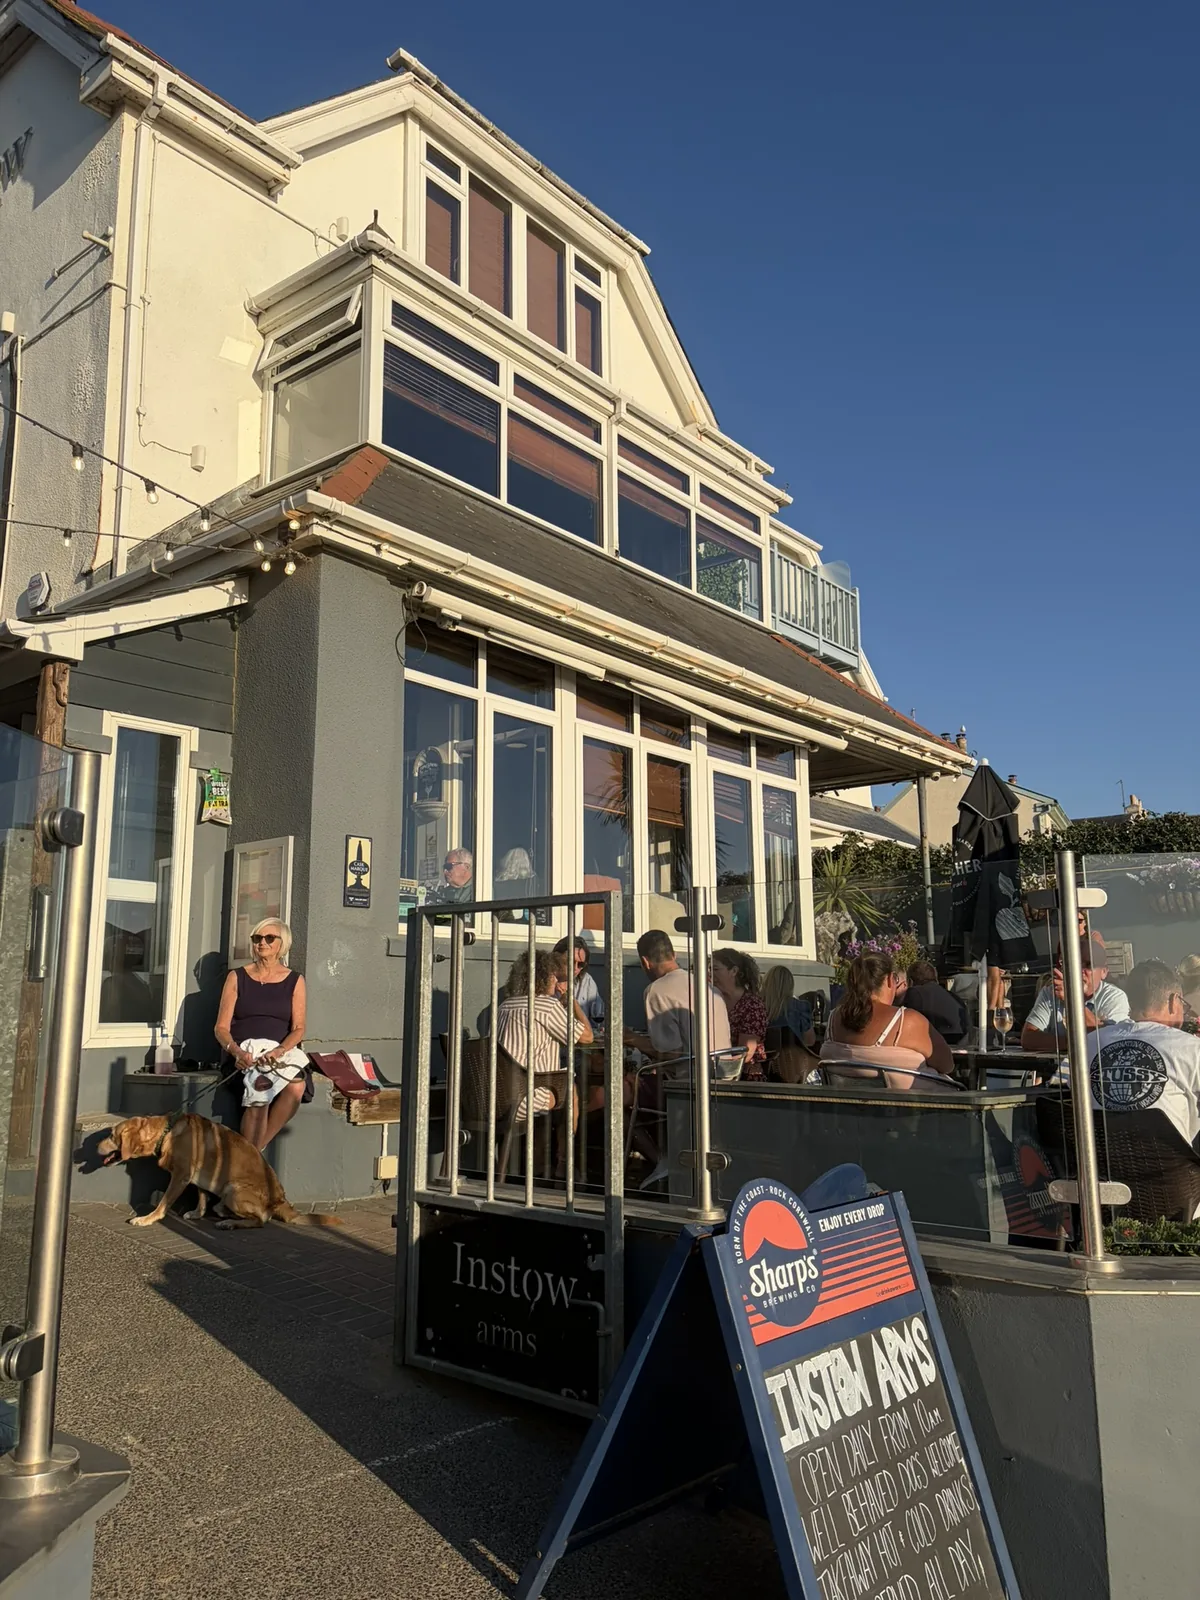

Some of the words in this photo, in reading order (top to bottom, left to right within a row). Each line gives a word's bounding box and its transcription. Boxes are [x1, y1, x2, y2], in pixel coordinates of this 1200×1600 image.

[1091, 1066, 1161, 1082] STUSSY
[733, 1219, 741, 1233] OF
[736, 1200, 748, 1217] THE
[788, 1197, 816, 1244] CORNWALL
[818, 1214, 844, 1233] ENJOY
[843, 1208, 867, 1225] EVERY
[866, 1203, 885, 1219] DROP
[733, 1236, 744, 1264] BORN
[452, 1241, 578, 1309] Instow
[749, 1255, 819, 1297] Sharp's
[762, 1290, 799, 1309] BREWING
[806, 1284, 817, 1294] CO
[477, 1320, 537, 1356] arms
[871, 1316, 937, 1410] ARMS
[799, 1441, 844, 1506] OPEN
[841, 1419, 879, 1478] DAILY
[877, 1406, 918, 1460] FROM
[800, 1503, 846, 1565] WELL
[841, 1469, 899, 1537] BEHAVED
[897, 1451, 929, 1500] DOGS
[816, 1536, 878, 1600] TAKEAWAY
[873, 1520, 902, 1580] HOT
[905, 1502, 937, 1555] COLD
[924, 1555, 957, 1600] ALL
